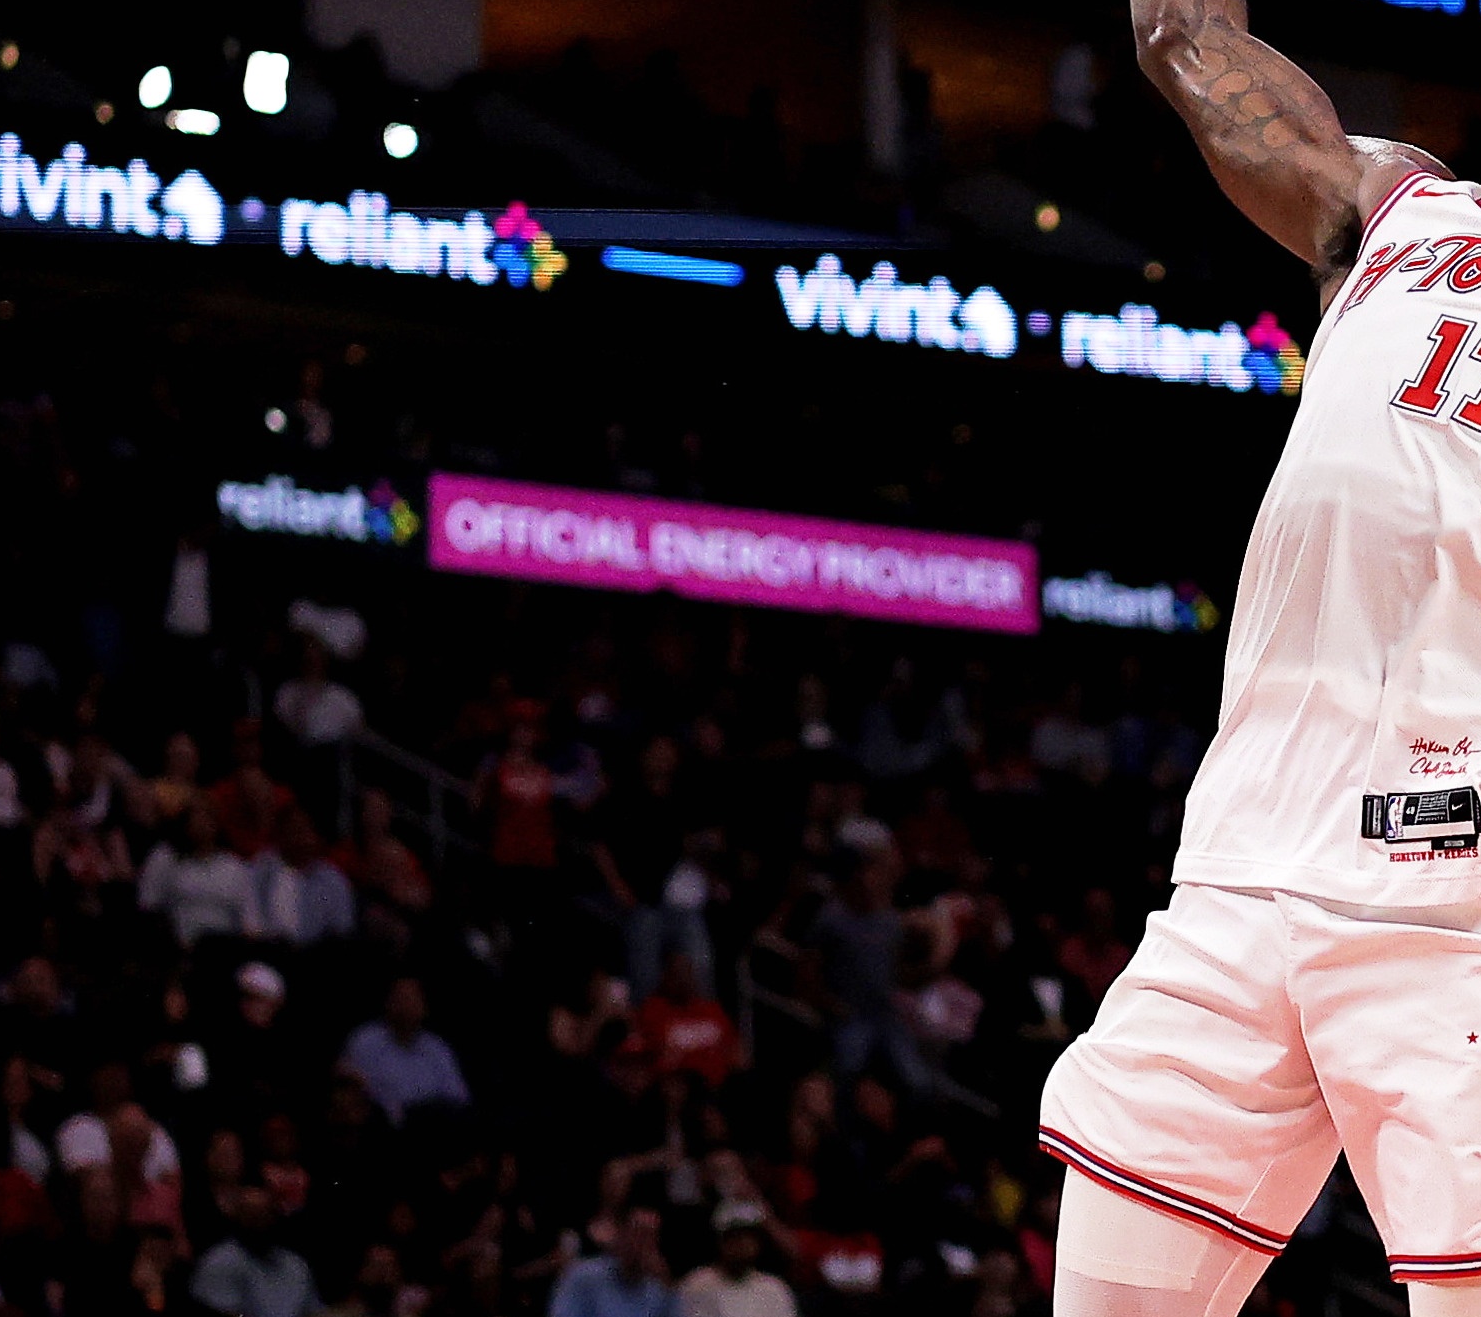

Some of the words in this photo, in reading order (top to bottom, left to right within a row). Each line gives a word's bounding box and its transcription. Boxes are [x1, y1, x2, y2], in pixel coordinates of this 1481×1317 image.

[280, 189, 498, 285] reliant
[775, 254, 961, 349] vivint
[1061, 303, 1254, 391] reliant
